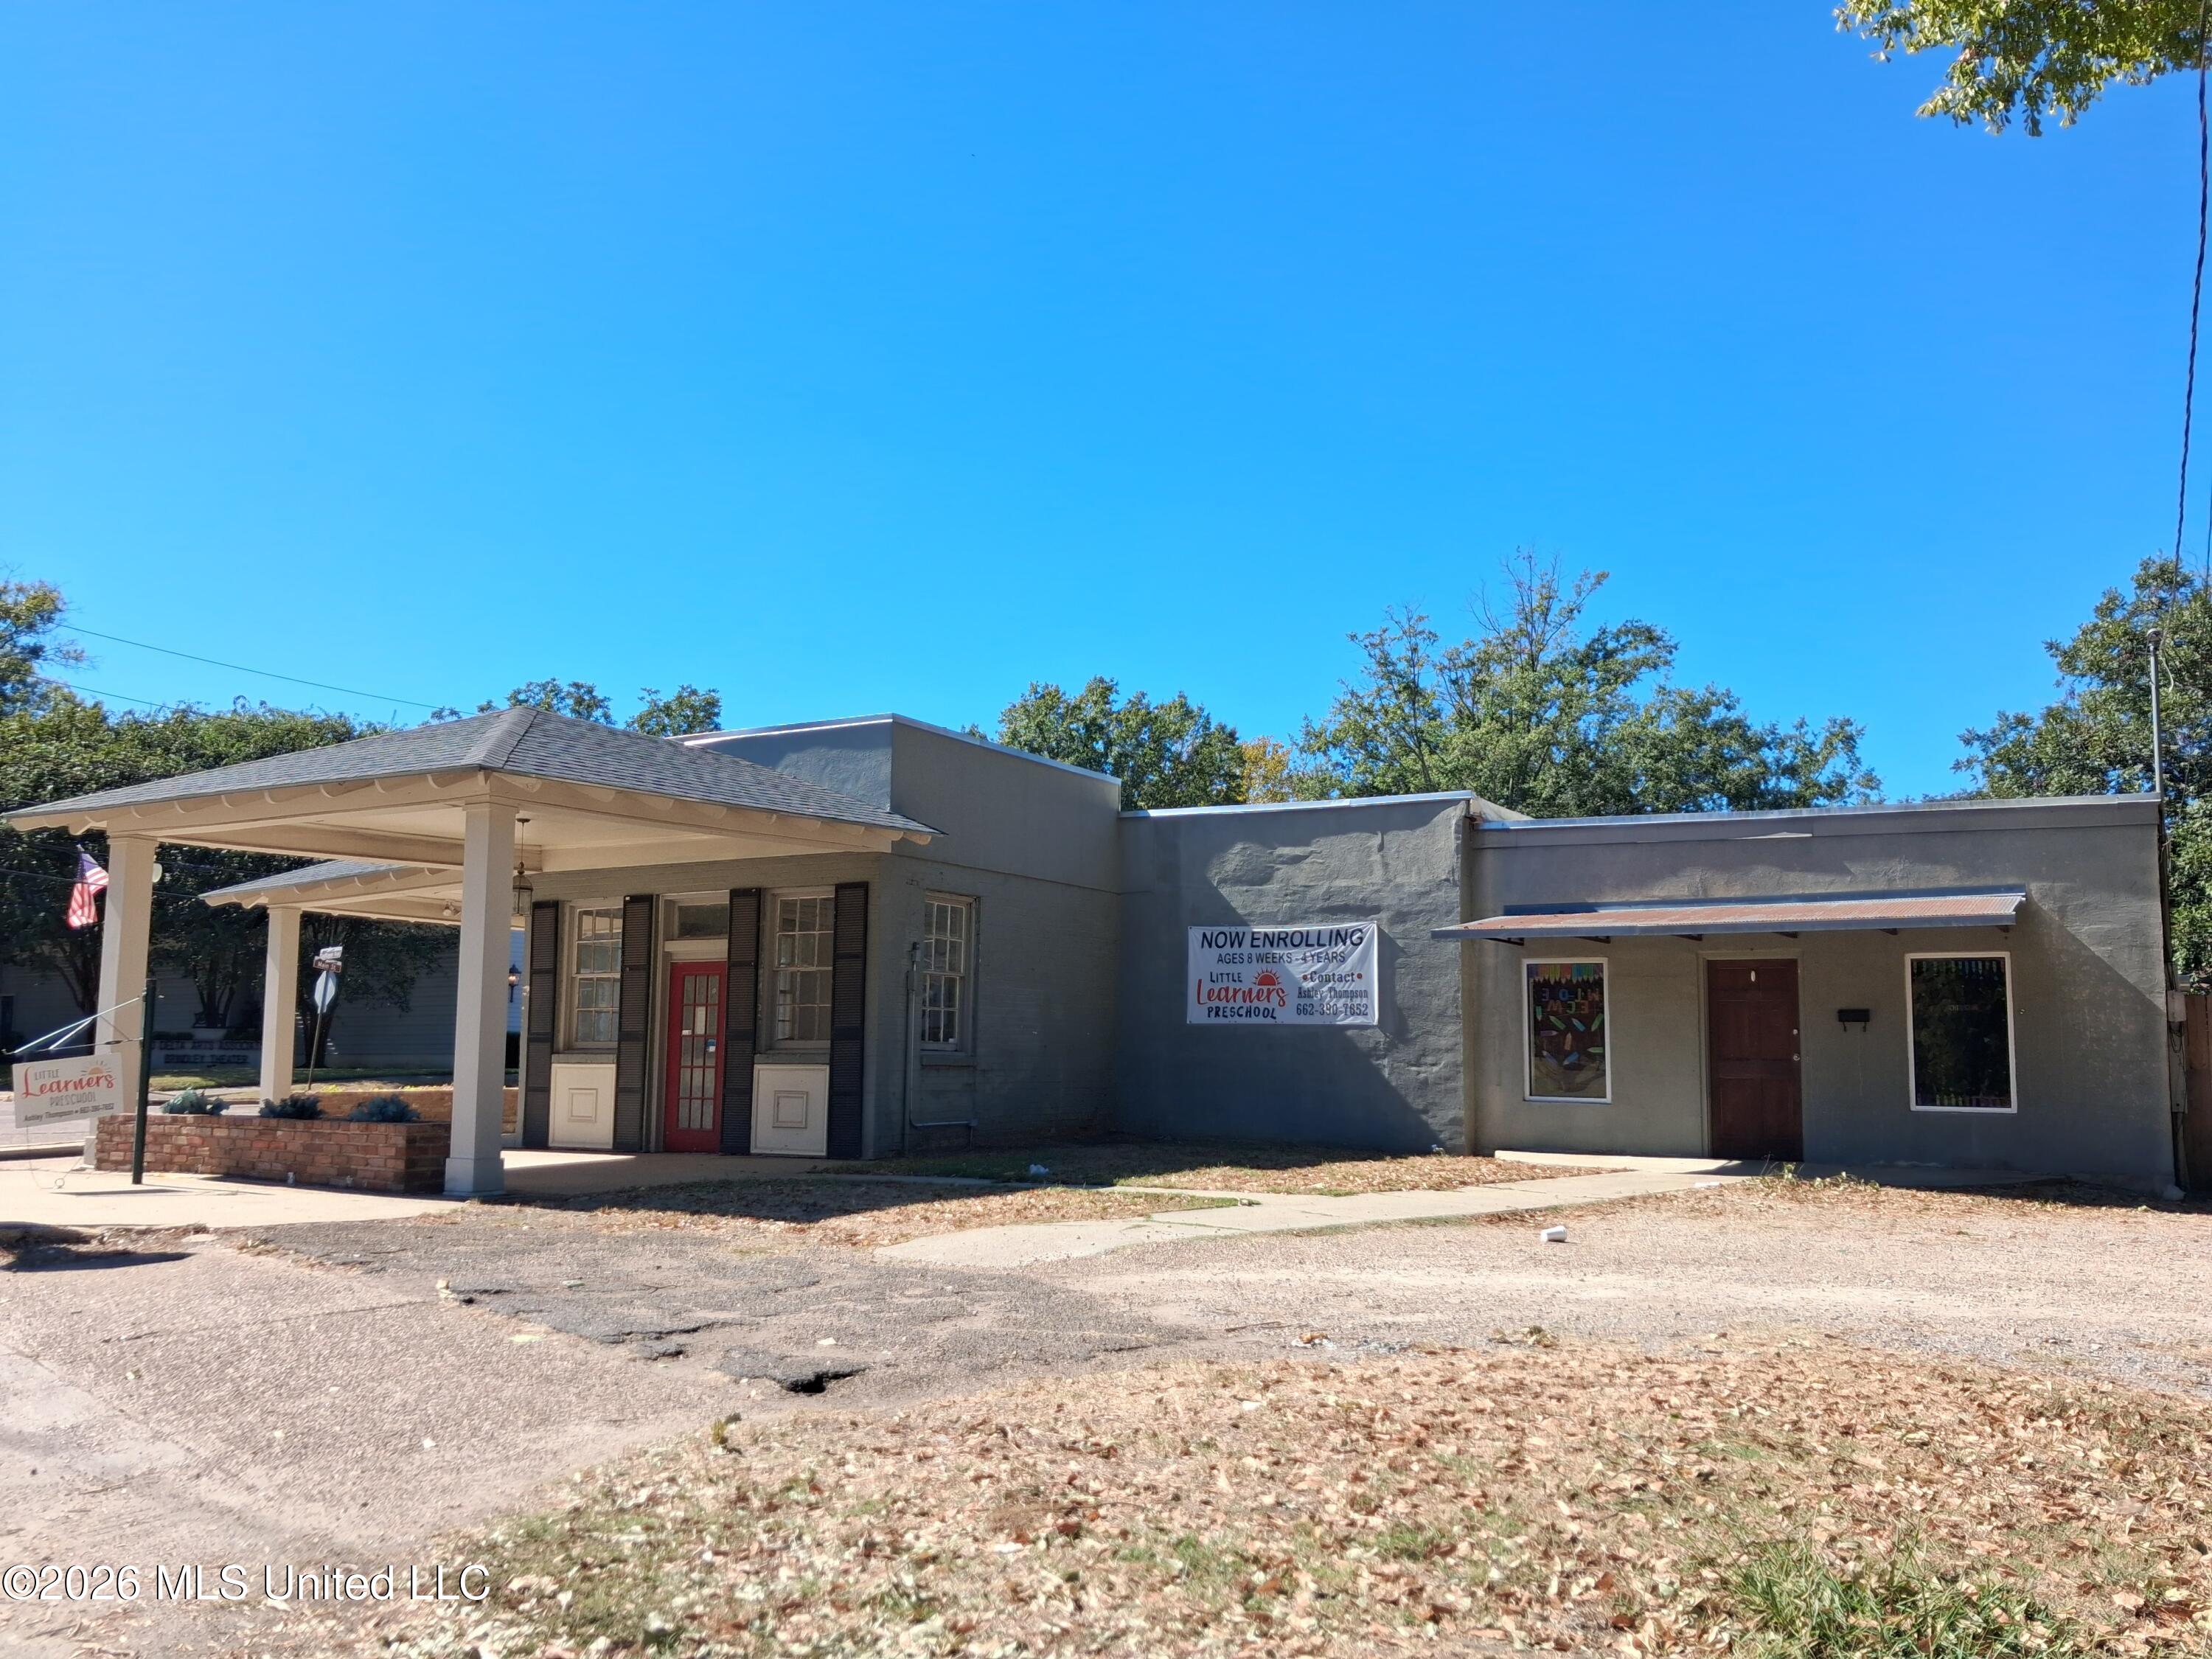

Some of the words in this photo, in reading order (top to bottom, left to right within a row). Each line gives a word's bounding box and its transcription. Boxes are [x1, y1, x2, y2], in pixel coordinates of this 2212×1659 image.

[1200, 931, 1245, 949] NOW
[1250, 928, 1364, 949] ENROLLING
[1217, 953, 1245, 964] AGES
[1247, 953, 1253, 964] 8
[1255, 952, 1292, 964] WEEKS
[1301, 953, 1307, 964] 4
[1309, 951, 1346, 964] YEARS
[1210, 972, 1242, 983] LITTLE
[1310, 971, 1355, 983] Contact
[1197, 978, 1288, 1007] Learners
[1297, 987, 1323, 1001] Ashley
[1328, 987, 1368, 1001] Thompson
[1207, 1006, 1276, 1020] PRESCHOOL
[1296, 1004, 1368, 1016] 662-390-7652
[34, 1069, 60, 1081] LITTLE
[21, 1066, 116, 1099] Learners
[49, 1091, 97, 1107] PRESCHOOL
